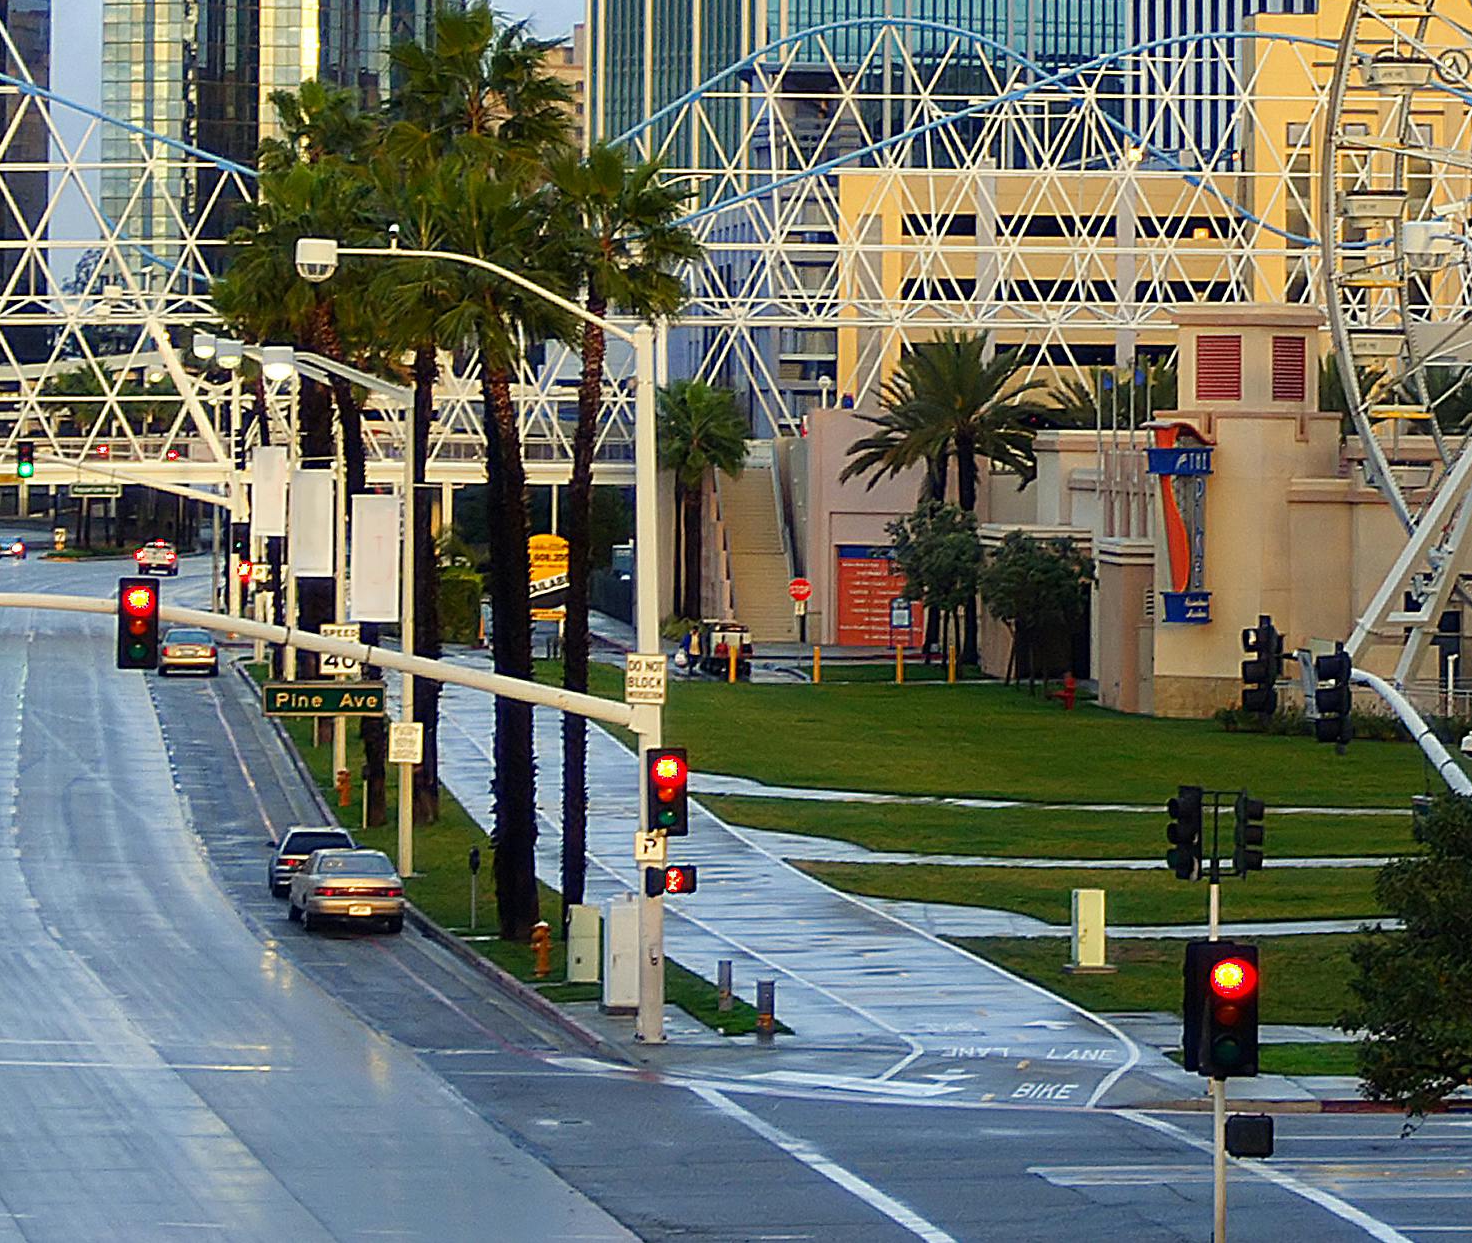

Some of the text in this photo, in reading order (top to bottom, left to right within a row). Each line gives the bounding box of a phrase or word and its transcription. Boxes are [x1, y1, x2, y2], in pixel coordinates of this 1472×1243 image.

[323, 628, 359, 638] SPEED
[323, 655, 356, 669] 40
[628, 660, 664, 672] DO NOT
[627, 676, 662, 688] BLOCK
[275, 692, 379, 708] Pine Ave
[1046, 1048, 1118, 1061] LANE
[1010, 1083, 1080, 1100] BIKE
